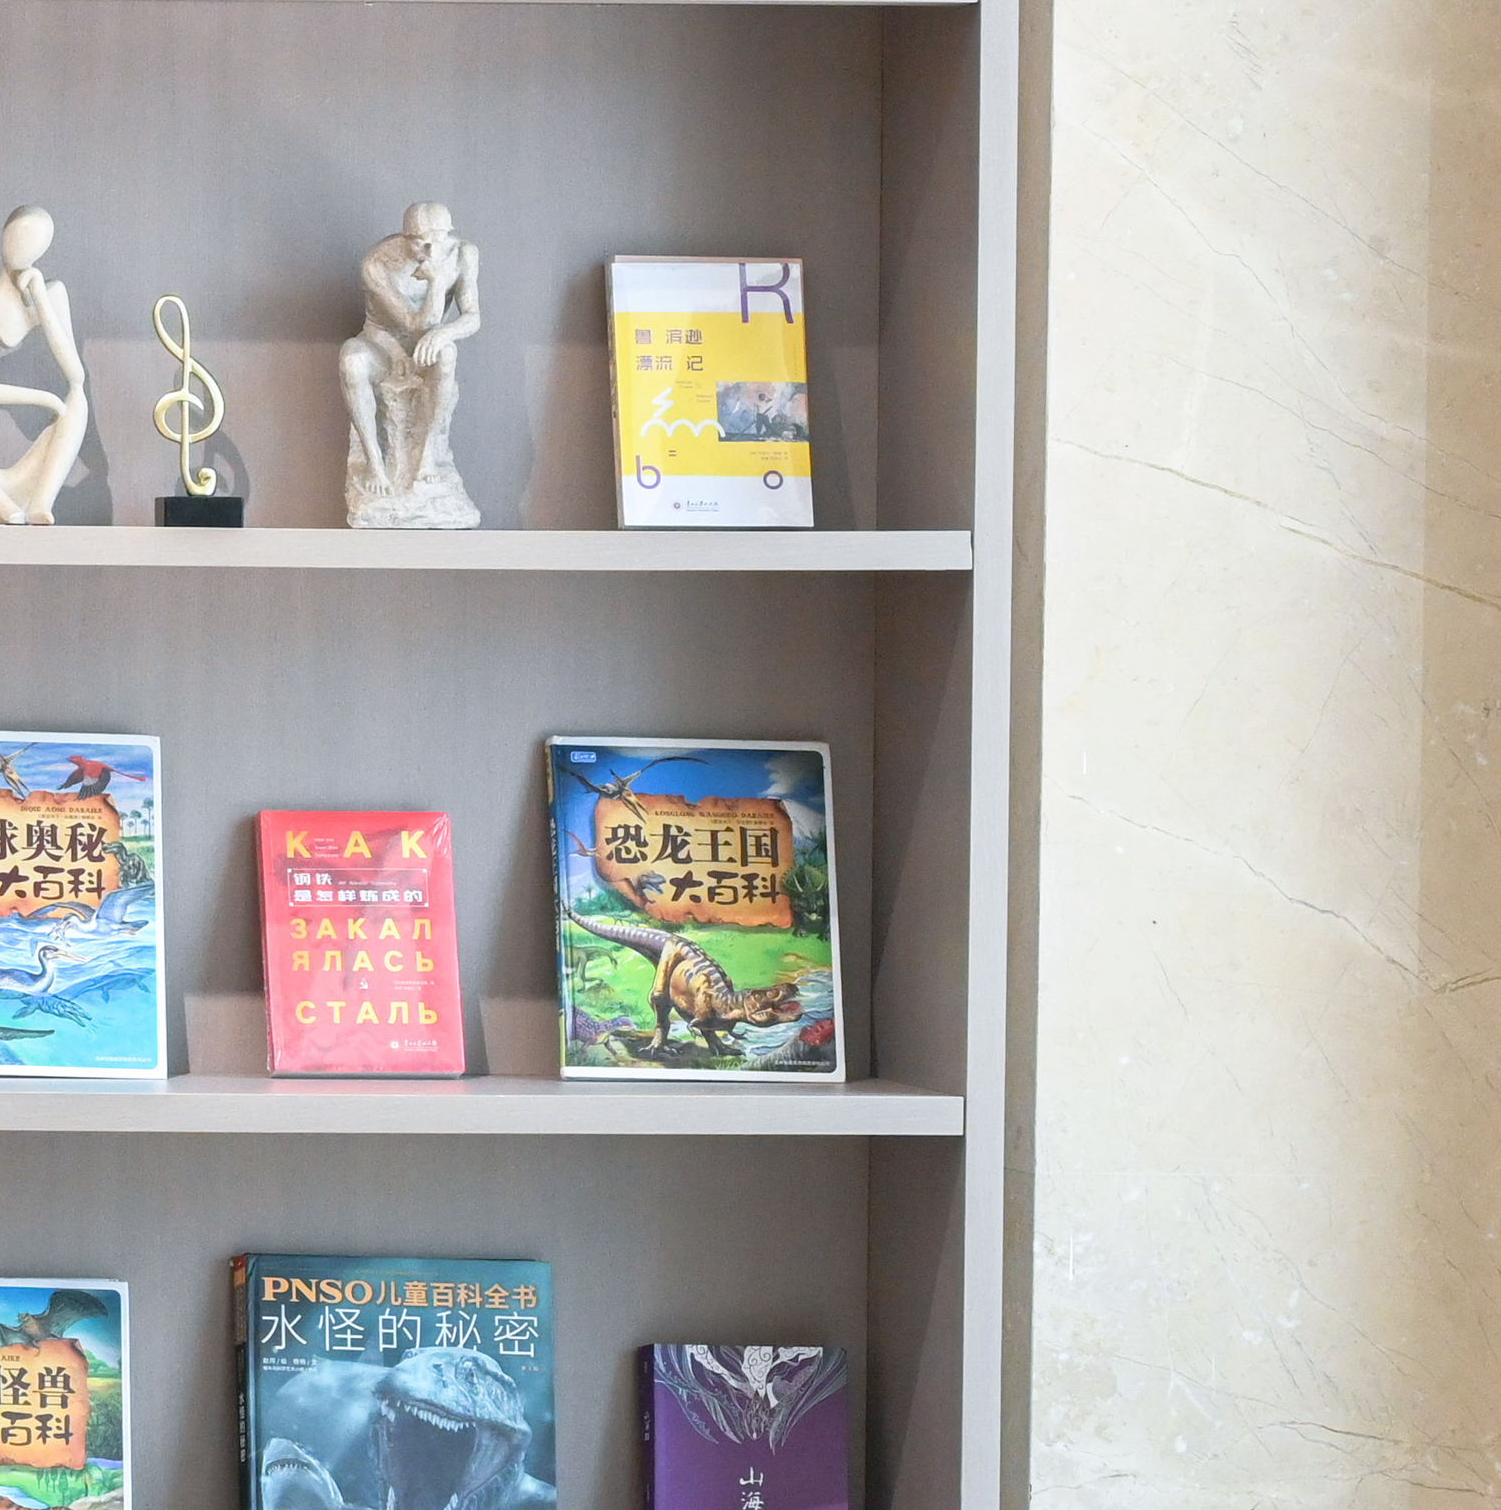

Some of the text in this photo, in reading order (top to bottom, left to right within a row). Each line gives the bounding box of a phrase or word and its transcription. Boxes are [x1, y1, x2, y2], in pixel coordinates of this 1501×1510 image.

[606, 824, 779, 868] 恐龙王国
[293, 873, 333, 886] 钢铁
[669, 871, 779, 907] 大百科
[293, 888, 423, 904] 是怎样炼成的
[290, 918, 433, 940] ЗАКАЛ
[291, 949, 435, 972] ЯЛАСЬ
[295, 1001, 438, 1026] СТАЛЬ
[260, 1306, 540, 1358] 水怪的秘密
